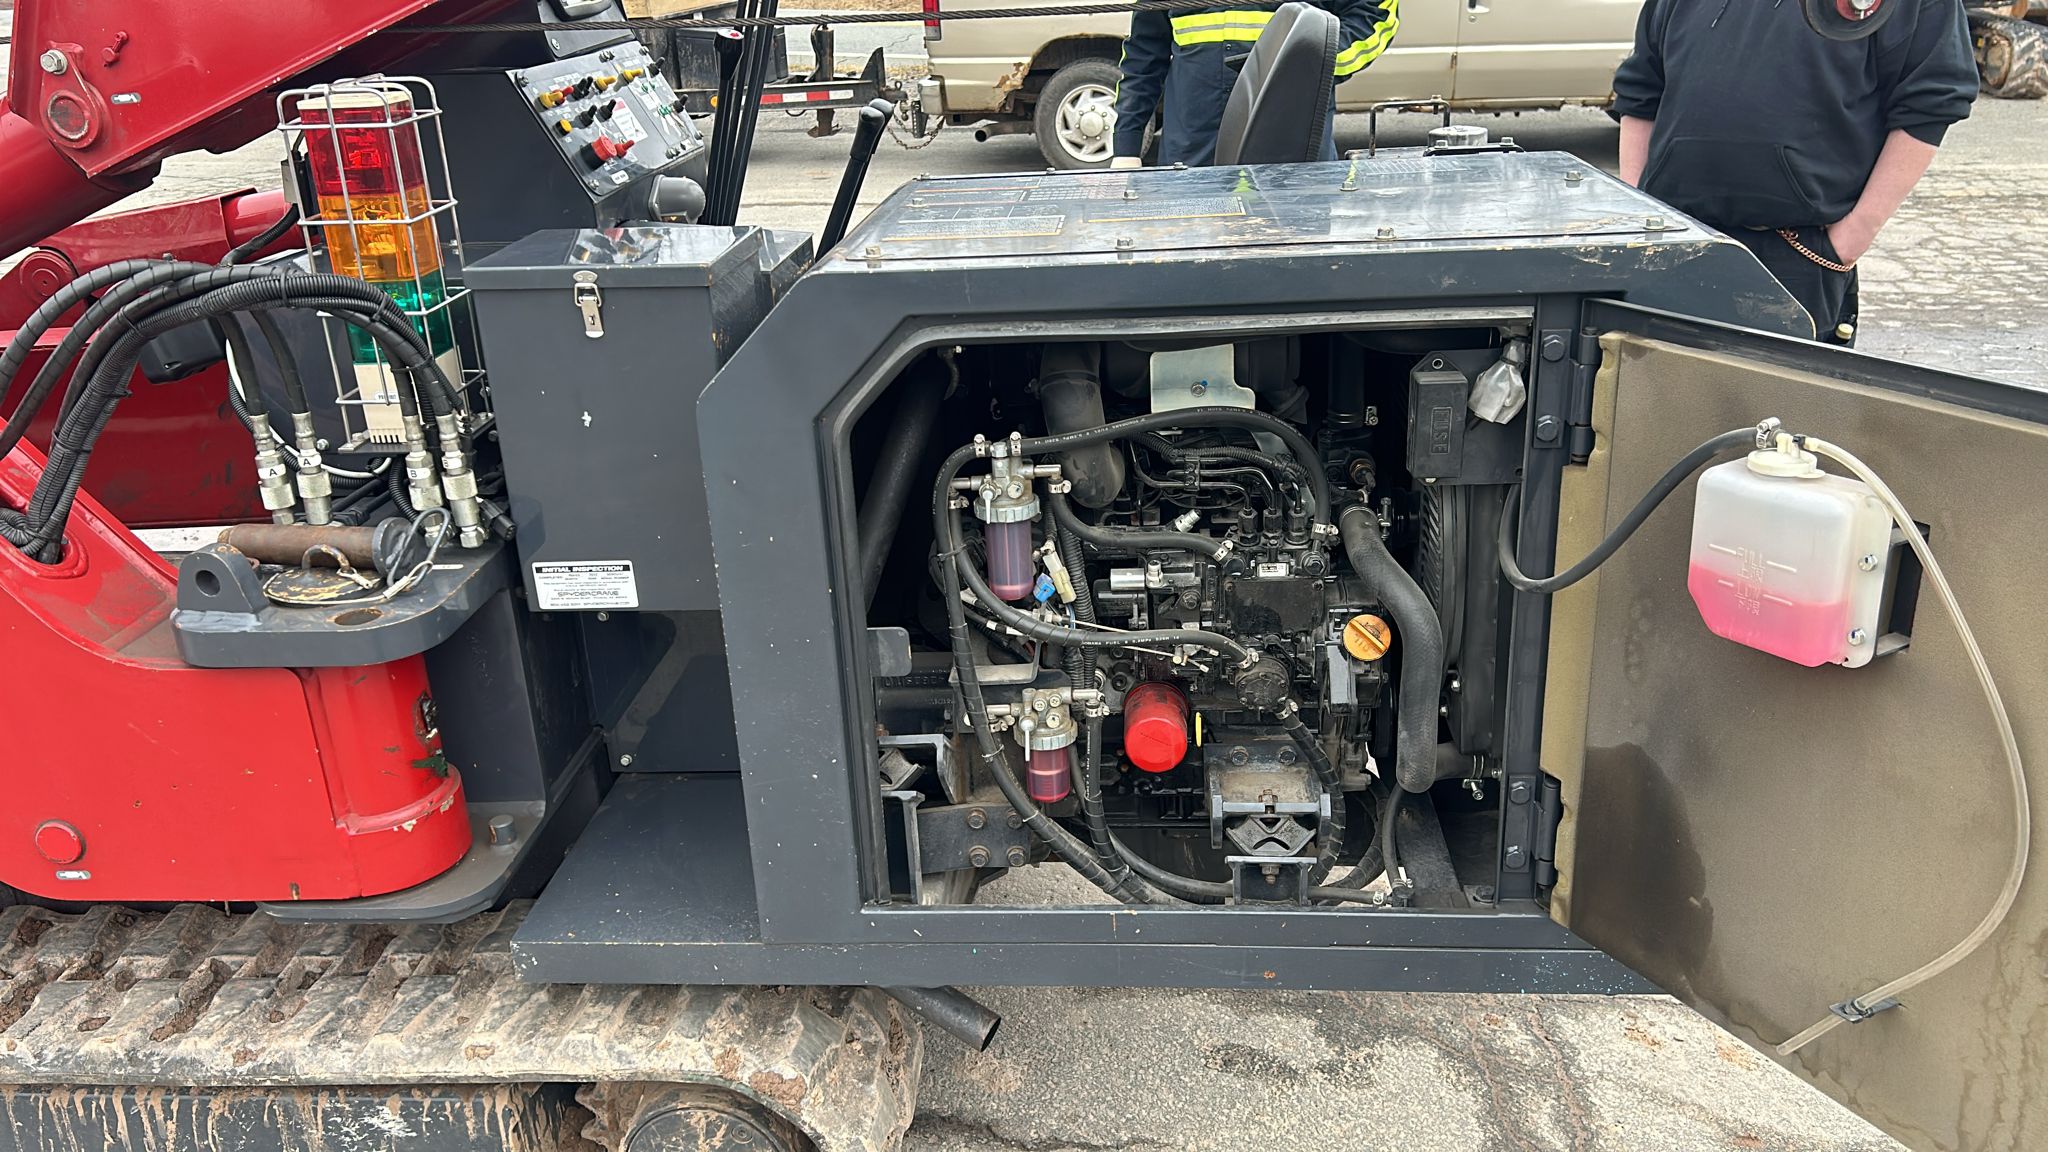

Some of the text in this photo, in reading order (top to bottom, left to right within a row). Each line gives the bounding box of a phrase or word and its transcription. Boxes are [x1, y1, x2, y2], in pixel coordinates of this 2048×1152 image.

[303, 457, 311, 466] A
[269, 468, 278, 477] A
[410, 469, 418, 478] B
